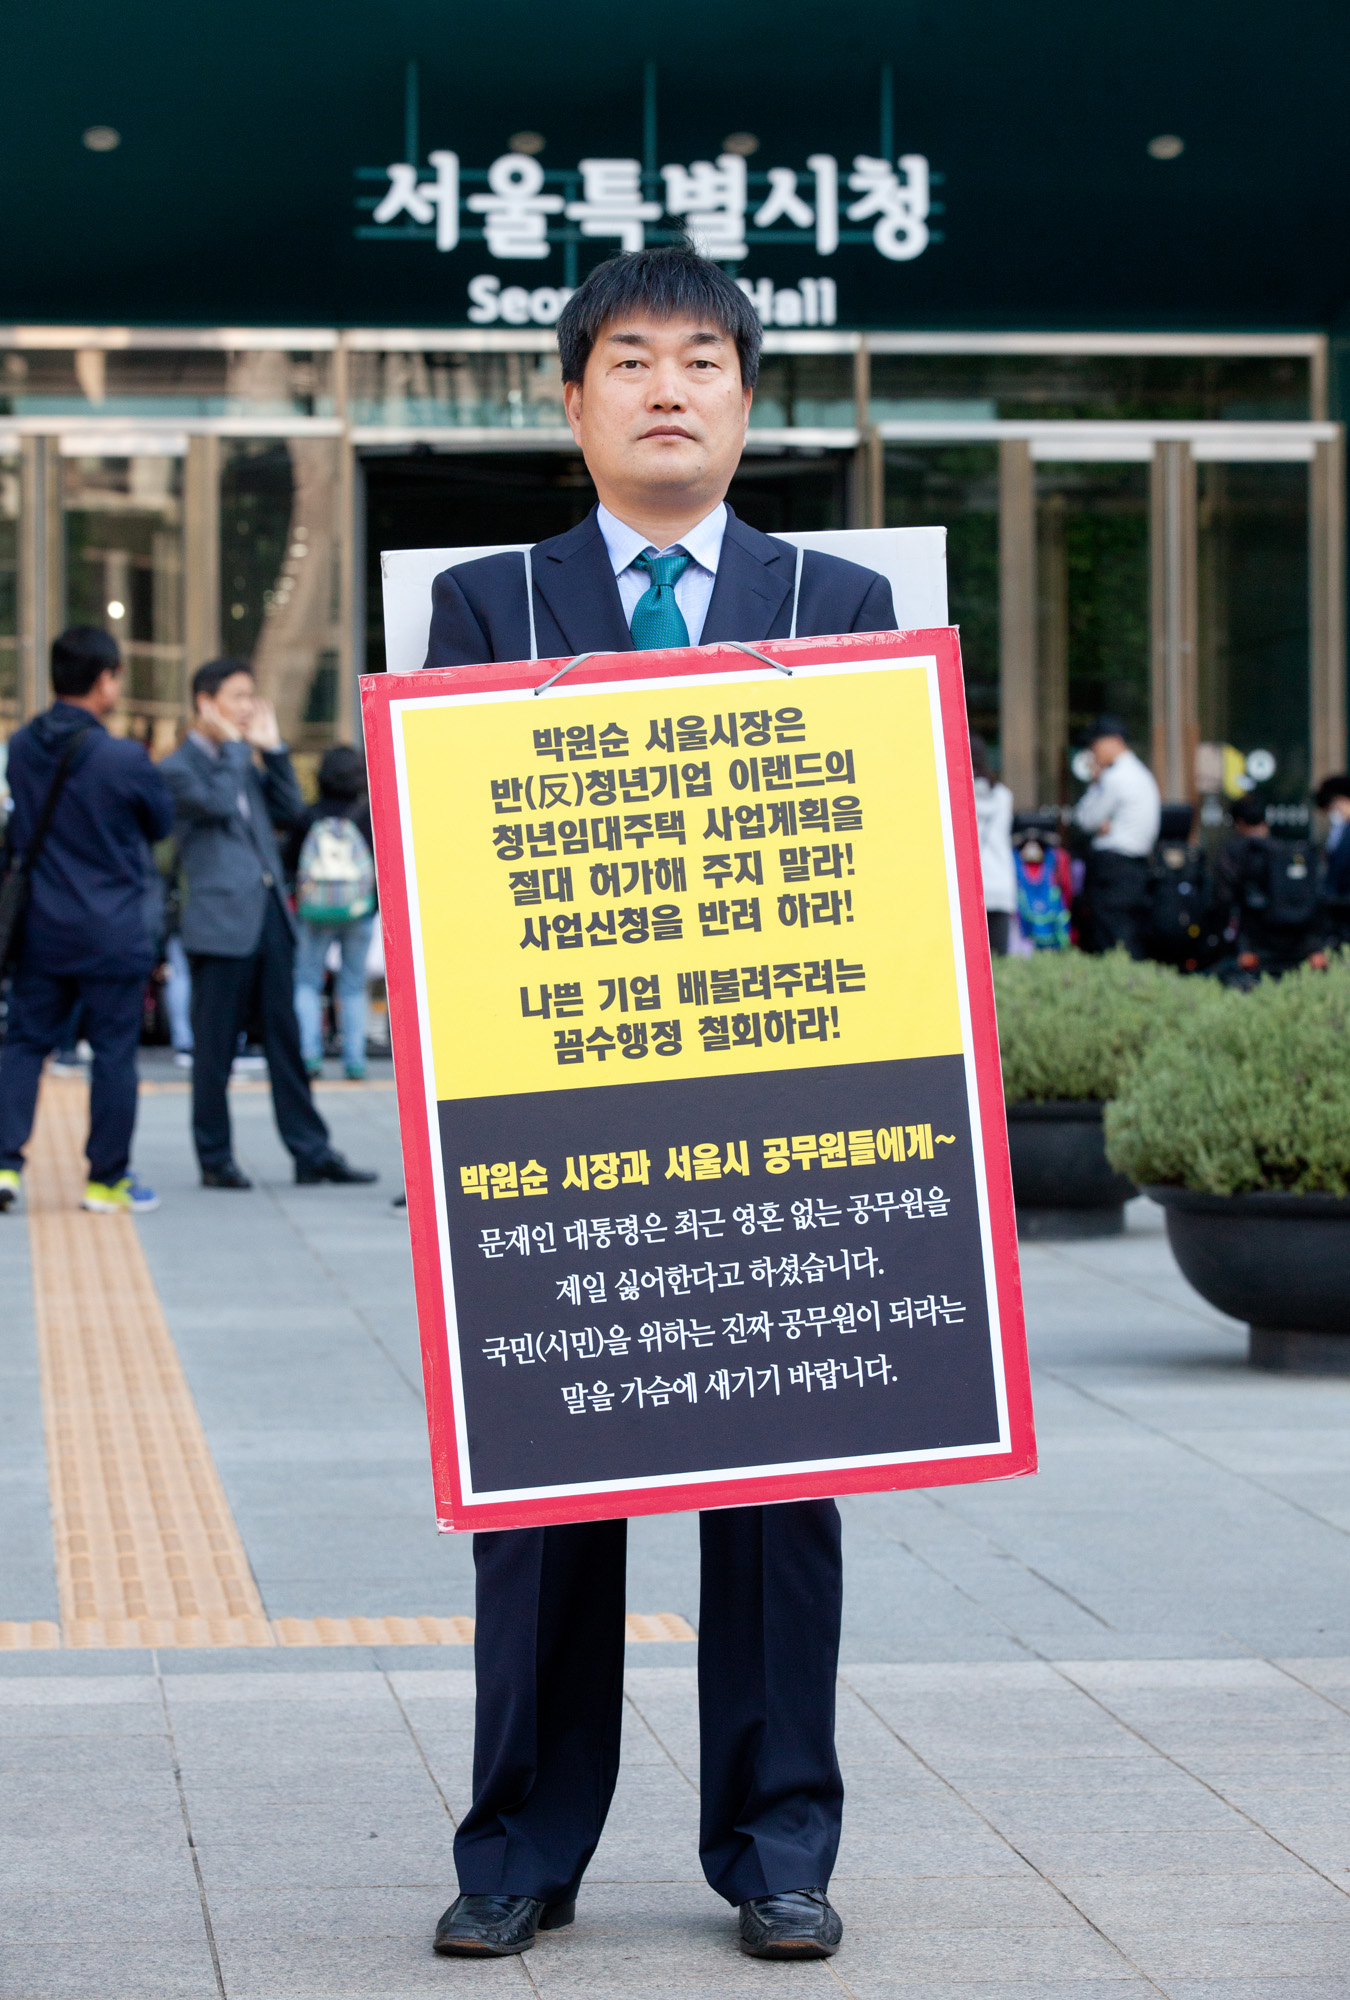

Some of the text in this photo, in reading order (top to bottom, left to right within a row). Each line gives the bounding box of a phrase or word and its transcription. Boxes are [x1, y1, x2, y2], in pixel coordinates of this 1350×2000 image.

[373, 150, 930, 260] 서울특별시청
[532, 707, 806, 762] 박원순 서울시장은
[490, 749, 856, 815] 반(反)청년기업 이랜드의
[492, 795, 863, 861] 청년임대주택 사업계획을
[508, 843, 856, 906] 절대 허가해 주지 말라!
[519, 889, 854, 951] 사업신청을 반려 하라!
[520, 958, 866, 1020] 나쁜 기업 배불려주려는
[554, 1006, 841, 1065] 꼼수행정 철회하라!
[459, 1123, 956, 1200] 박원순 시장과 서울시 공무원들에게~
[478, 1186, 951, 1259] 문재인 대통령은 최근 영혼 없는 공무원을
[555, 1246, 885, 1306] 제일 싫어한다고 하셨습니다.
[482, 1295, 966, 1367] 국민(시민)을 위하는 진짜 공무원이 되라는
[561, 1353, 898, 1415] 말을 가슴에 새기기 바랍니다.
